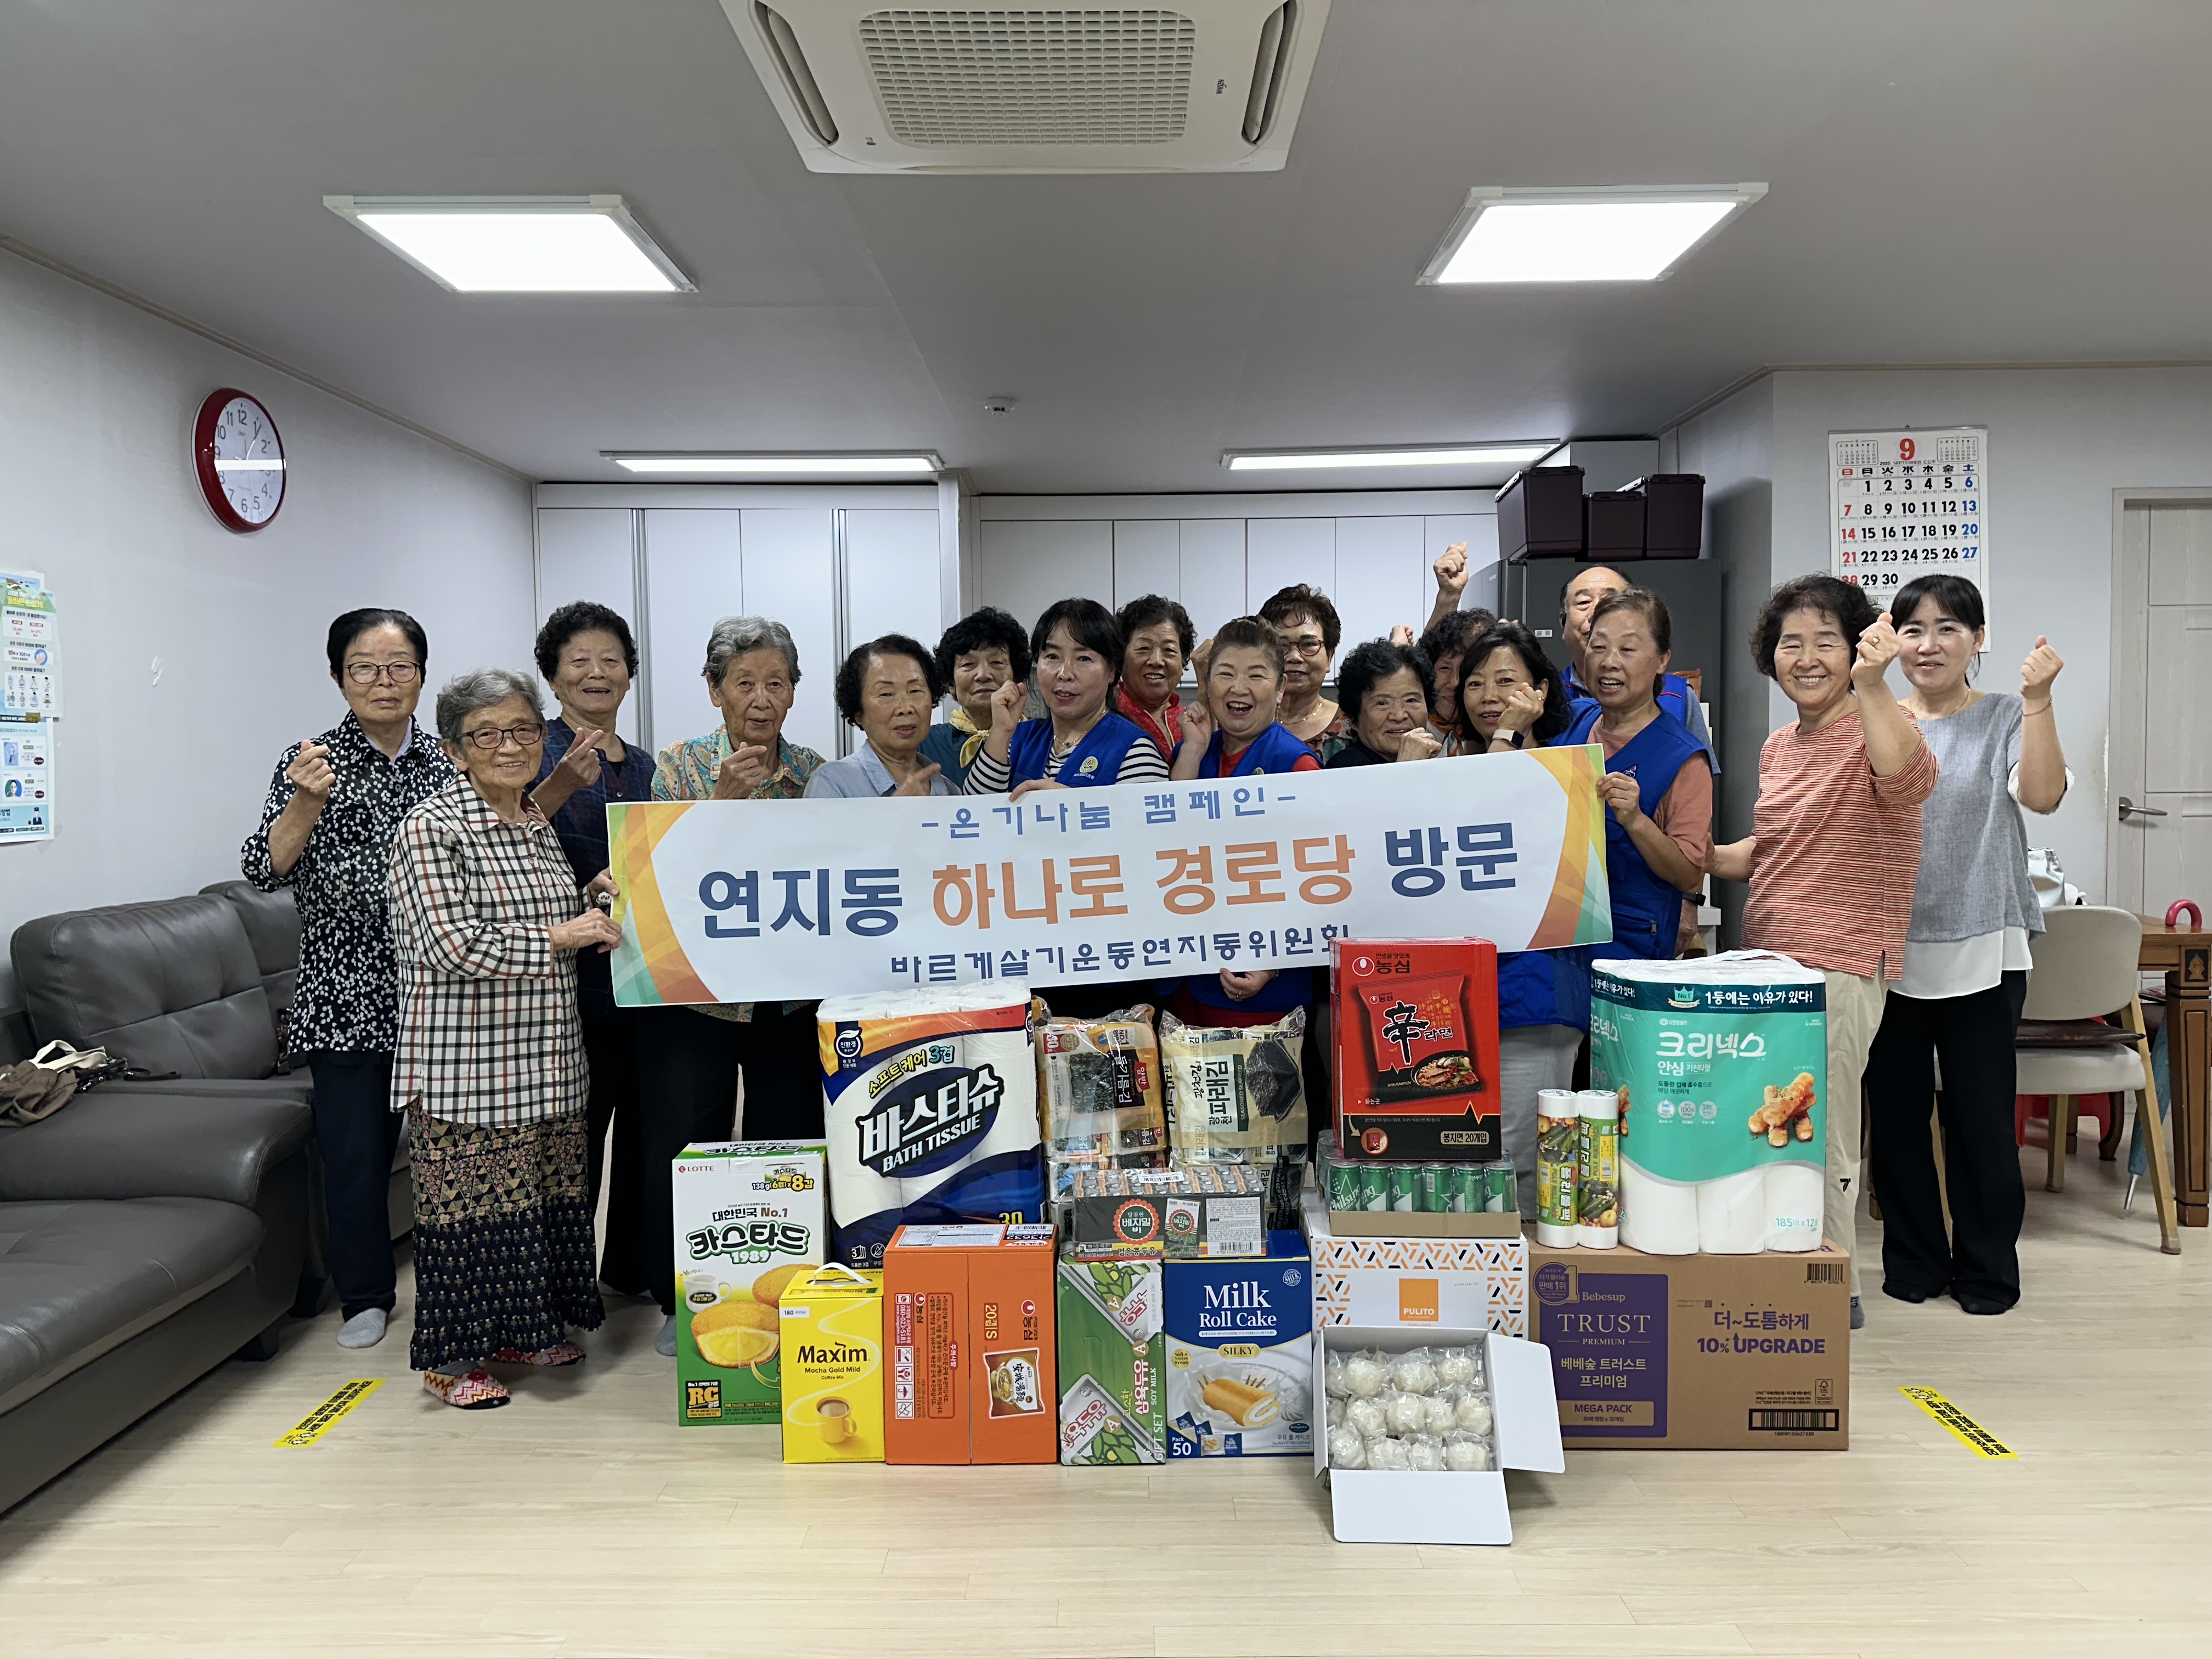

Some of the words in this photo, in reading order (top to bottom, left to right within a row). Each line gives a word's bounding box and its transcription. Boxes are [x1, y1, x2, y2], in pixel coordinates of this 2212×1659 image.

[227, 410, 233, 426] 11
[238, 410, 247, 425] 12
[261, 439, 268, 454] 2
[1899, 438, 1915, 461] 9
[1882, 466, 1894, 475] 火
[1902, 466, 1914, 474] 水
[1922, 465, 1934, 473] 木
[1943, 464, 1954, 472] 金
[261, 483, 268, 497] 4
[1865, 480, 1870, 492] 1
[1884, 479, 1892, 491] 2
[1905, 479, 1912, 490] 3
[1925, 478, 1933, 489] 4
[1944, 477, 1953, 489] 5
[1965, 476, 1973, 487] 6
[228, 488, 235, 503] 7
[253, 496, 260, 510] 5
[241, 498, 247, 513] 6
[1844, 504, 1852, 516] 7
[1864, 504, 1872, 515] 8
[1884, 503, 1892, 514] 9
[1901, 503, 1916, 514] 10
[1922, 502, 1936, 513] 11
[1942, 501, 1956, 512] 12
[1962, 500, 1977, 511] 13
[1842, 528, 1856, 540] 14
[1861, 527, 1876, 539] 15
[1882, 527, 1896, 538] 16
[1902, 526, 1916, 537] 17
[1922, 525, 1937, 537] 18
[1942, 524, 1957, 535] 19
[1961, 524, 1978, 535] 20
[1842, 551, 1857, 563] 21
[1861, 551, 1877, 562] 22
[1881, 550, 1898, 561] 23
[1901, 549, 1918, 560] 24
[1922, 549, 1938, 560] 25
[1942, 548, 1959, 559] 26
[1962, 547, 1978, 558] 27
[1861, 574, 1878, 585] 29
[1882, 573, 1898, 584] 30
[697, 867, 904, 939] 연지동
[933, 857, 1128, 929] 하나로
[1155, 834, 1356, 915] 경로당
[1385, 822, 1518, 897] 방문
[1376, 960, 1410, 974] 농심
[1705, 991, 1751, 1006] 1등에는
[1752, 991, 1786, 1005] 이유가
[1788, 990, 1813, 1004] 있다!
[1381, 1000, 1430, 1065] 辛
[1424, 1027, 1453, 1041] 라면
[1656, 1031, 1767, 1059] 크리넥스
[868, 1052, 928, 1098] 소프트케어
[928, 1045, 955, 1065] 3겹
[1137, 1066, 1147, 1085] 양반
[1657, 1060, 1684, 1076] 안심
[1686, 1064, 1711, 1073] 키친타월
[1114, 1055, 1132, 1103] 들기름김
[1190, 1063, 1204, 1098] 광천김
[1205, 1060, 1231, 1115] 파래김
[857, 1066, 1003, 1163] 바스티슈
[1208, 1116, 1232, 1126] 광천
[882, 1144, 923, 1173] BATH
[924, 1113, 981, 1153] TISSUE
[1443, 1132, 1463, 1143] 봉지면
[1465, 1133, 1487, 1143] 20개입
[704, 1146, 804, 1155] 카스타드
[712, 1207, 757, 1222] 대한민국
[760, 1207, 788, 1218] No.1
[1122, 1217, 1151, 1227] 베지밀
[1775, 1218, 1800, 1227] 185매
[687, 1221, 809, 1257] 카스타드
[731, 1250, 770, 1264] 1989
[1538, 1281, 1553, 1290] 판매
[1554, 1281, 1566, 1290] 1위
[1203, 1280, 1272, 1309] Milk
[1582, 1291, 1626, 1304] Bebesup
[916, 1305, 924, 1324] 농심
[1199, 1311, 1232, 1328] Roll
[1236, 1310, 1277, 1327] Cake
[1714, 1310, 1809, 1331] 더~도톰하게
[1023, 1316, 1034, 1341] 농심
[1557, 1314, 1651, 1334] TRUST
[797, 1341, 868, 1364] Maxim
[1223, 1347, 1254, 1355] SILKY
[1697, 1337, 1731, 1355] 10%
[1733, 1335, 1825, 1355] UPGRADE
[1561, 1357, 1596, 1371] 베베숲
[1599, 1357, 1647, 1371] 트러스트
[1133, 1358, 1150, 1415] 삼육두유
[1579, 1374, 1627, 1389] 프리미엄
[688, 1387, 719, 1405] RC
[1120, 1389, 1133, 1417] 고소한
[1574, 1403, 1604, 1414] MEGA
[1606, 1403, 1633, 1413] PACK
[1153, 1412, 1163, 1433] SET
[1153, 1436, 1164, 1461] GIFT
[1172, 1443, 1192, 1455] 50
